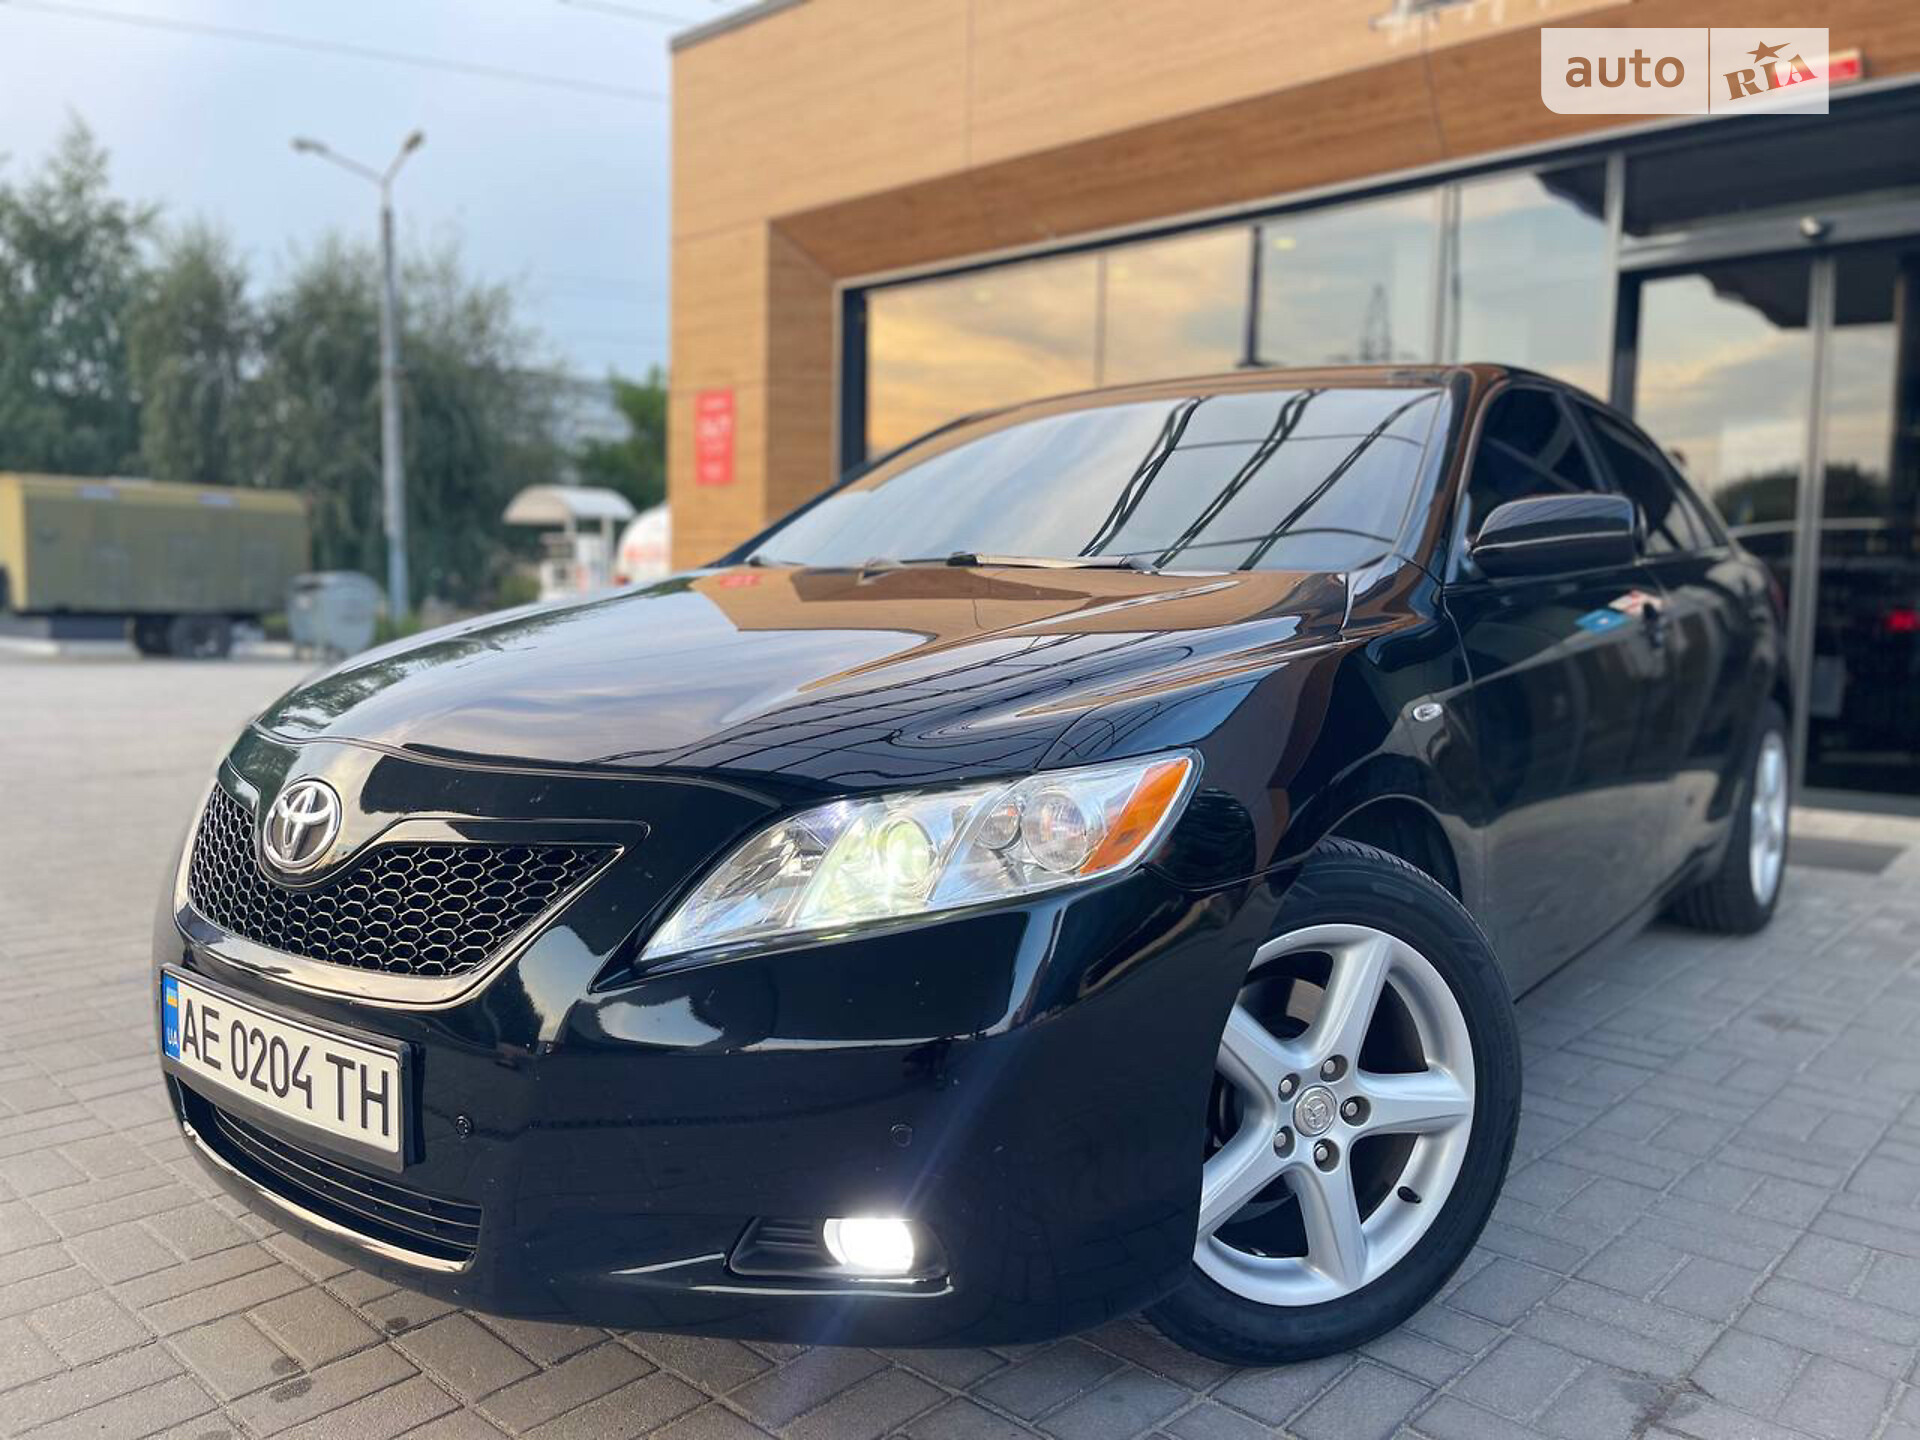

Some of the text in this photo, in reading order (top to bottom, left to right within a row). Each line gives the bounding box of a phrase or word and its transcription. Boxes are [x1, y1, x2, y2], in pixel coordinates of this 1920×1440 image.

[182, 998, 389, 1137] AE 0204 TH
